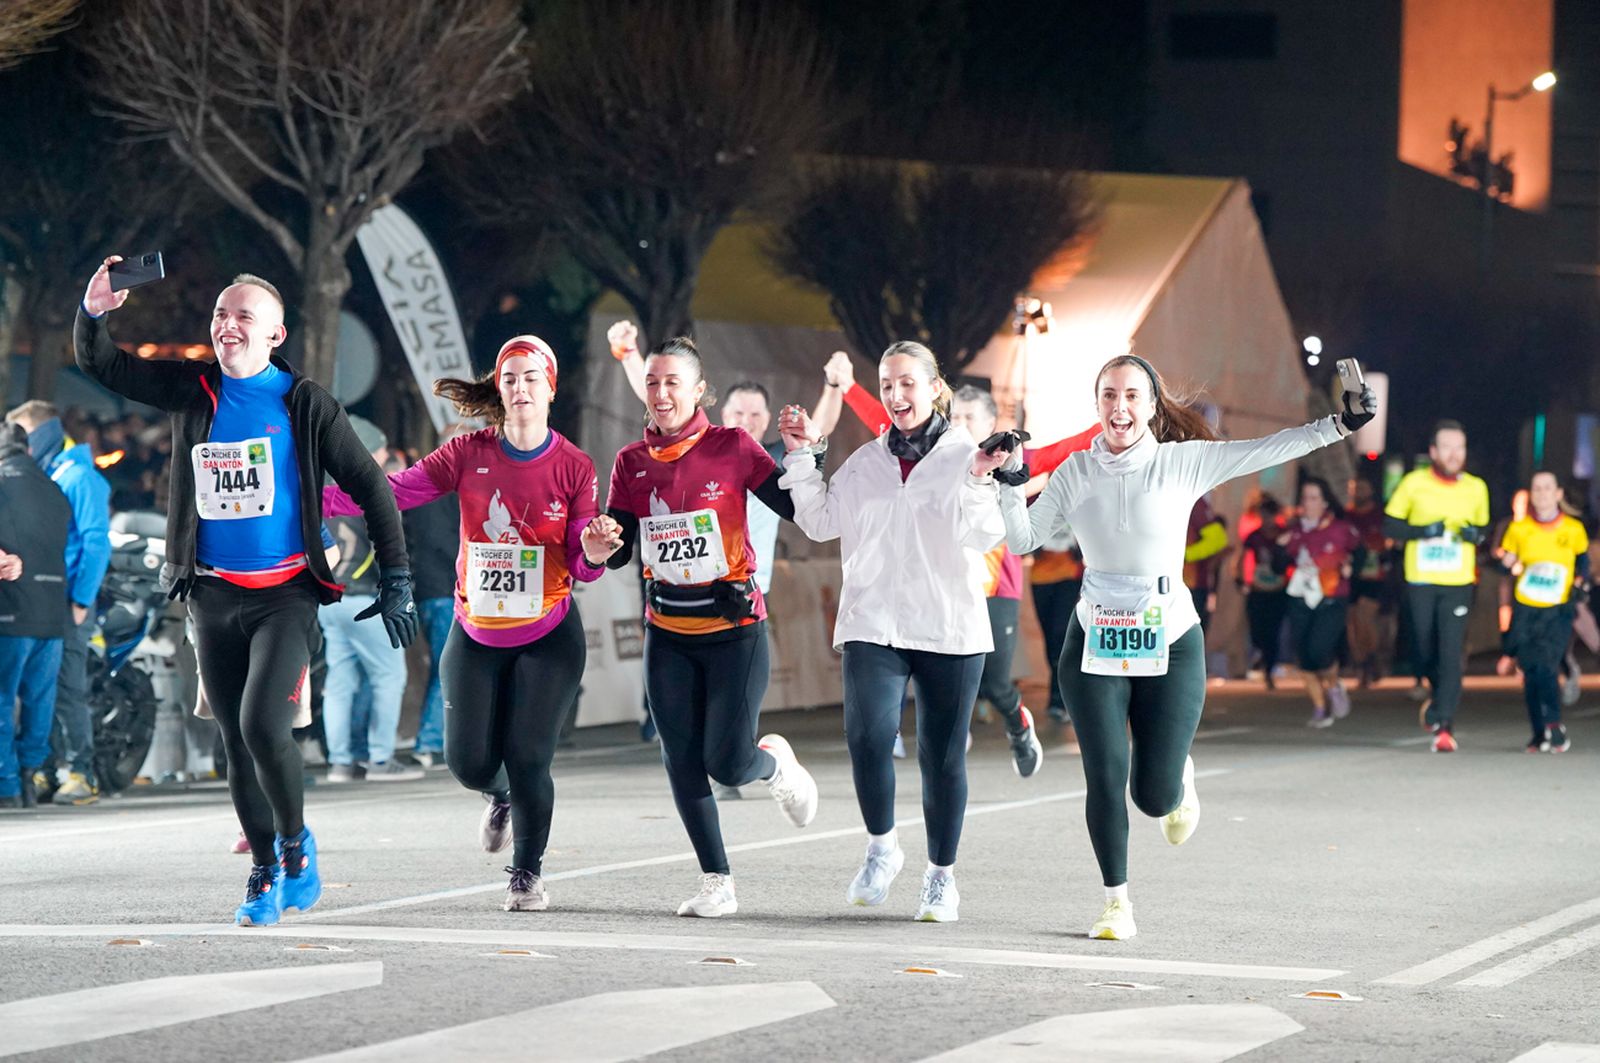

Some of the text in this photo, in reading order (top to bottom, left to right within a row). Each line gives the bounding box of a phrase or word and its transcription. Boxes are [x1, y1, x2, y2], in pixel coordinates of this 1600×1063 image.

[232, 450, 242, 459] DE
[203, 460, 218, 469] SAN
[212, 468, 260, 492] 7444
[656, 522, 677, 532] NOCHE
[679, 519, 688, 528] DE
[650, 532, 664, 542] SAN
[657, 536, 709, 563] 2232
[481, 551, 513, 560] NOCHE DE
[480, 569, 525, 592] 2231
[1103, 608, 1125, 616] NOCHE
[1095, 617, 1108, 625] SAN
[1099, 628, 1156, 650] 13190
